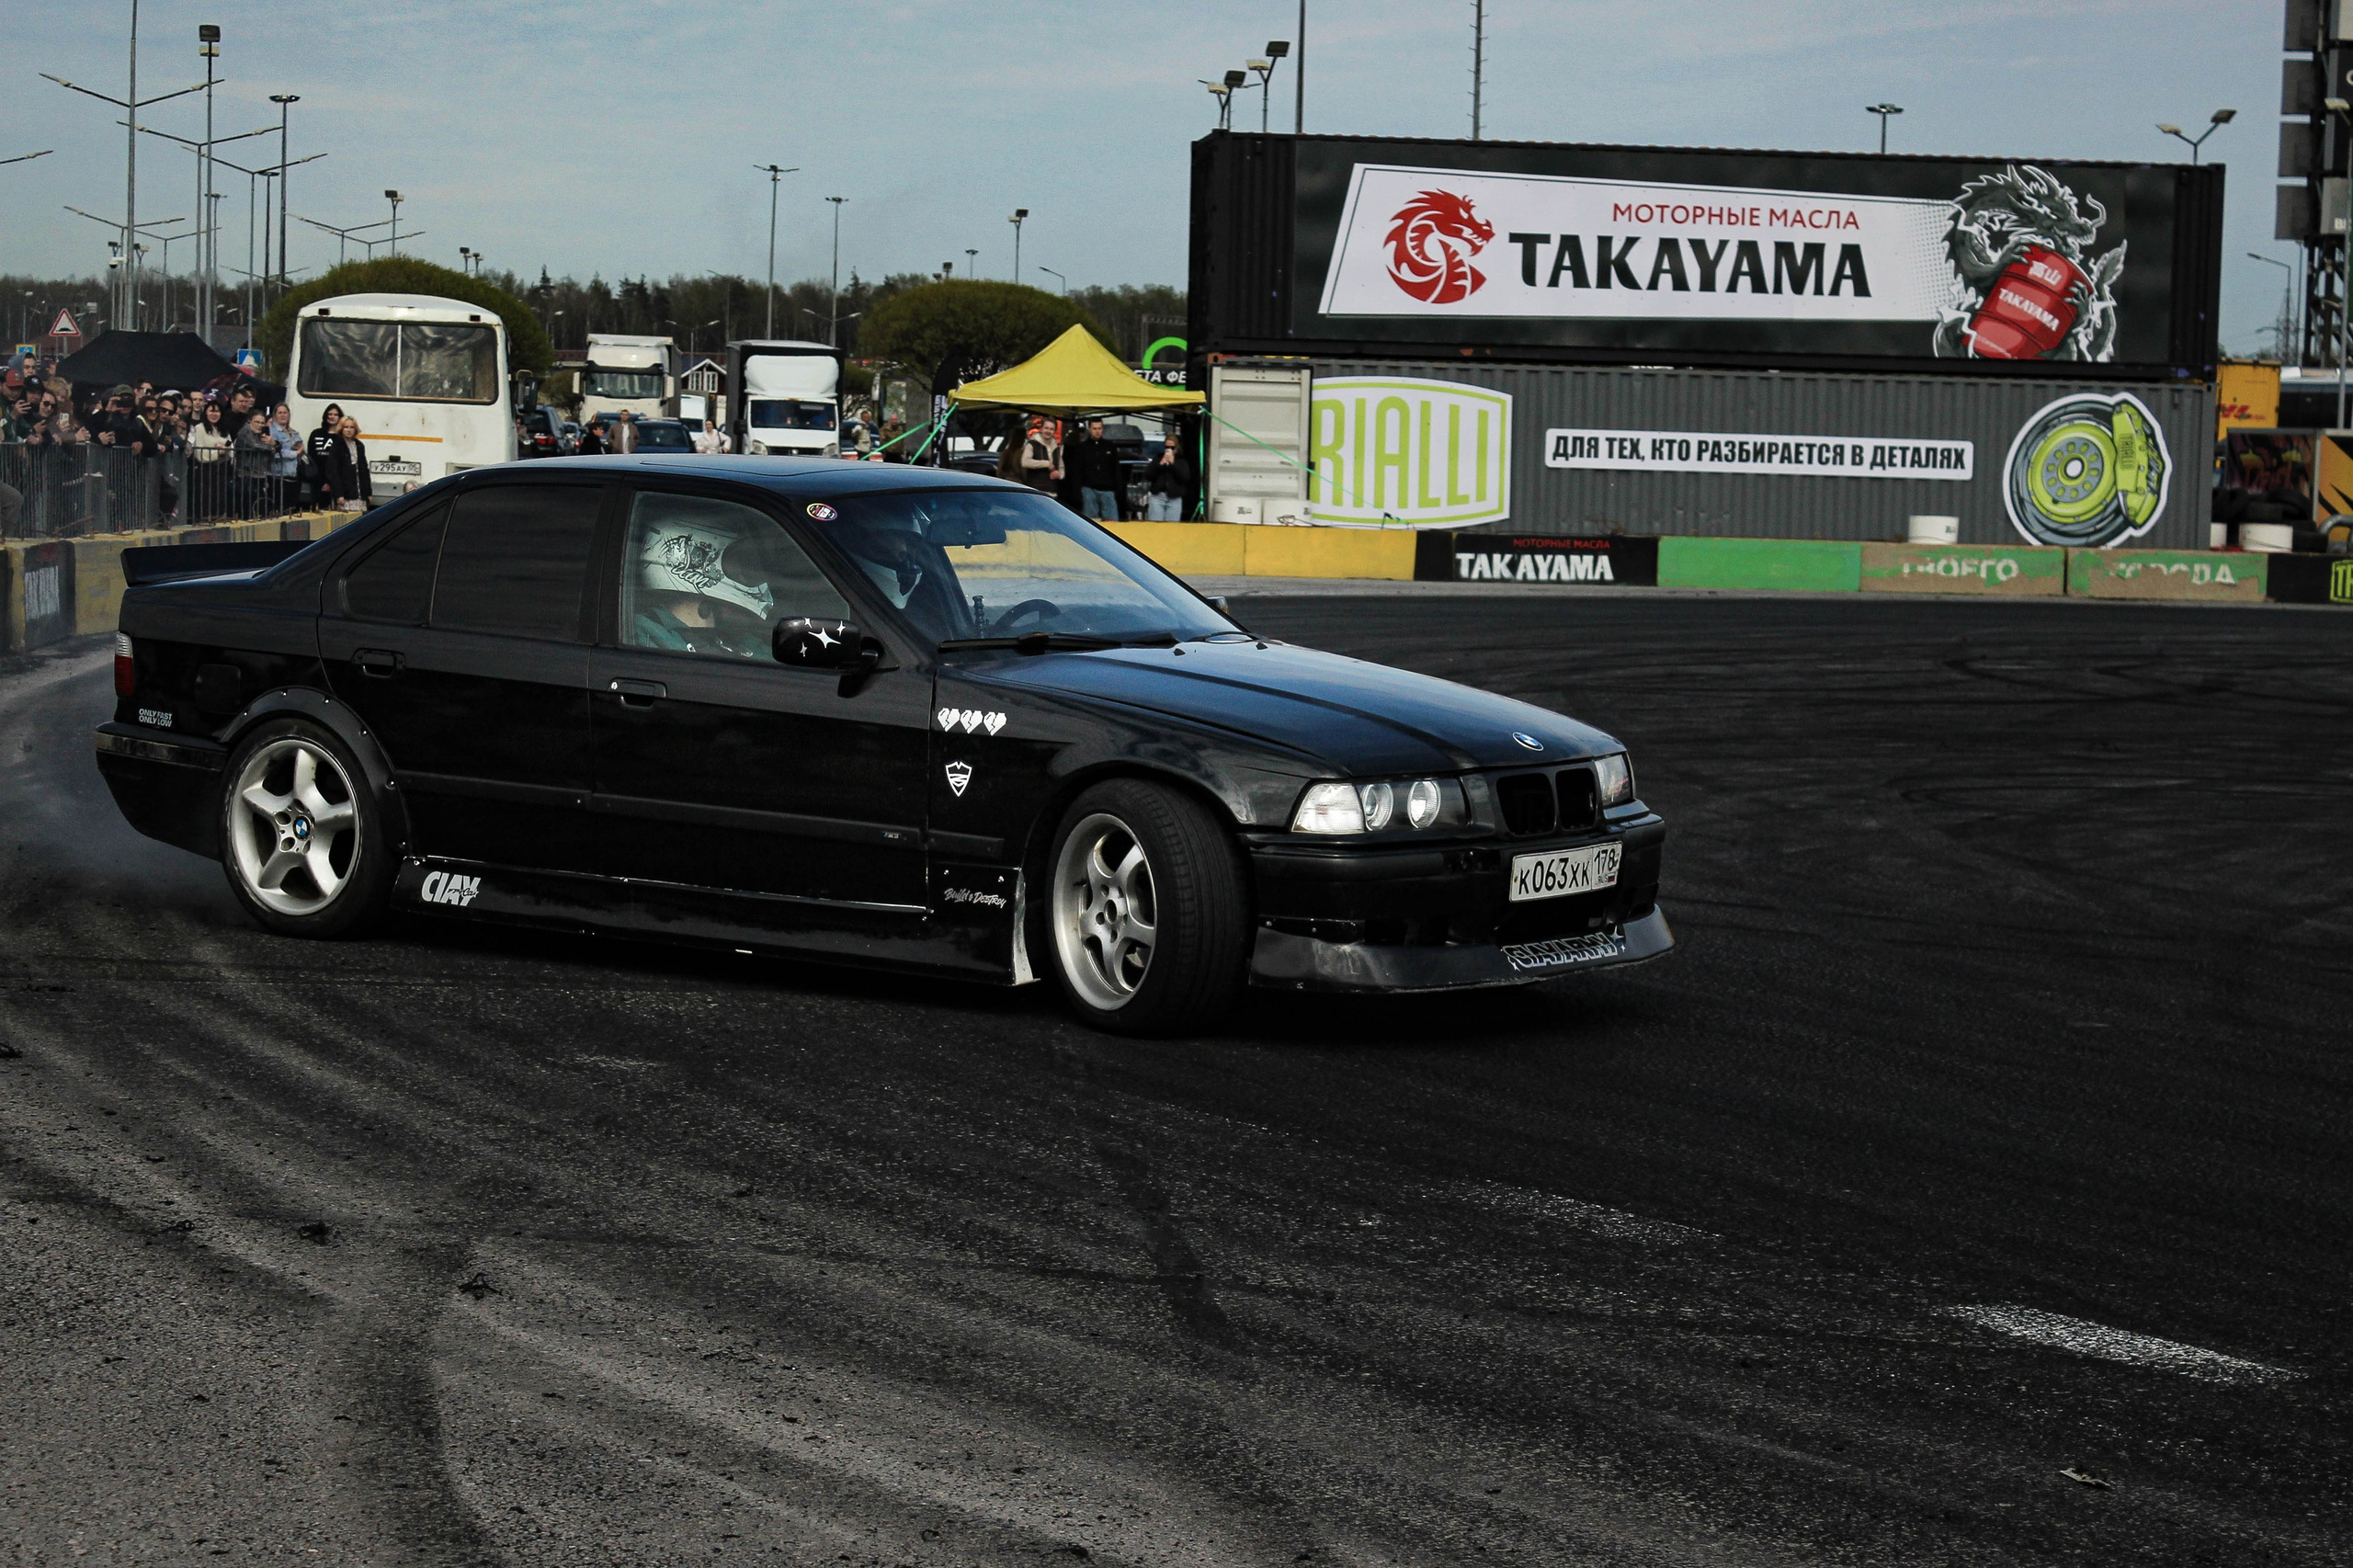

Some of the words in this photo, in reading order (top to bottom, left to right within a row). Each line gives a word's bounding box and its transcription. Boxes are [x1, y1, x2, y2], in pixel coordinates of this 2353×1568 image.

[1612, 202, 1761, 227] МОТОРНЫЕ
[1769, 208, 1860, 231] МАСЛА
[1508, 231, 1872, 298] TAKAYAMA
[1999, 288, 2061, 332] TAKAYAMA
[1552, 435, 1599, 461] ДЛЯ
[1605, 437, 1645, 461] ТЕХ,
[1651, 437, 1691, 461] КТО
[1697, 438, 1845, 467] РАЗБИРАЕТСЯ
[1850, 444, 1864, 467] В
[1870, 445, 1966, 471] ДЕТАЛЯХ
[1513, 538, 1573, 549] МОТОРНЫЕ
[1573, 540, 1610, 550] МАСЛА
[1455, 552, 1614, 581] TAKAYAMA
[139, 708, 157, 717] ONLY
[157, 711, 172, 720] FAST
[139, 716, 157, 724] ONLY
[157, 719, 172, 727] LOW
[1593, 847, 1616, 875] 178
